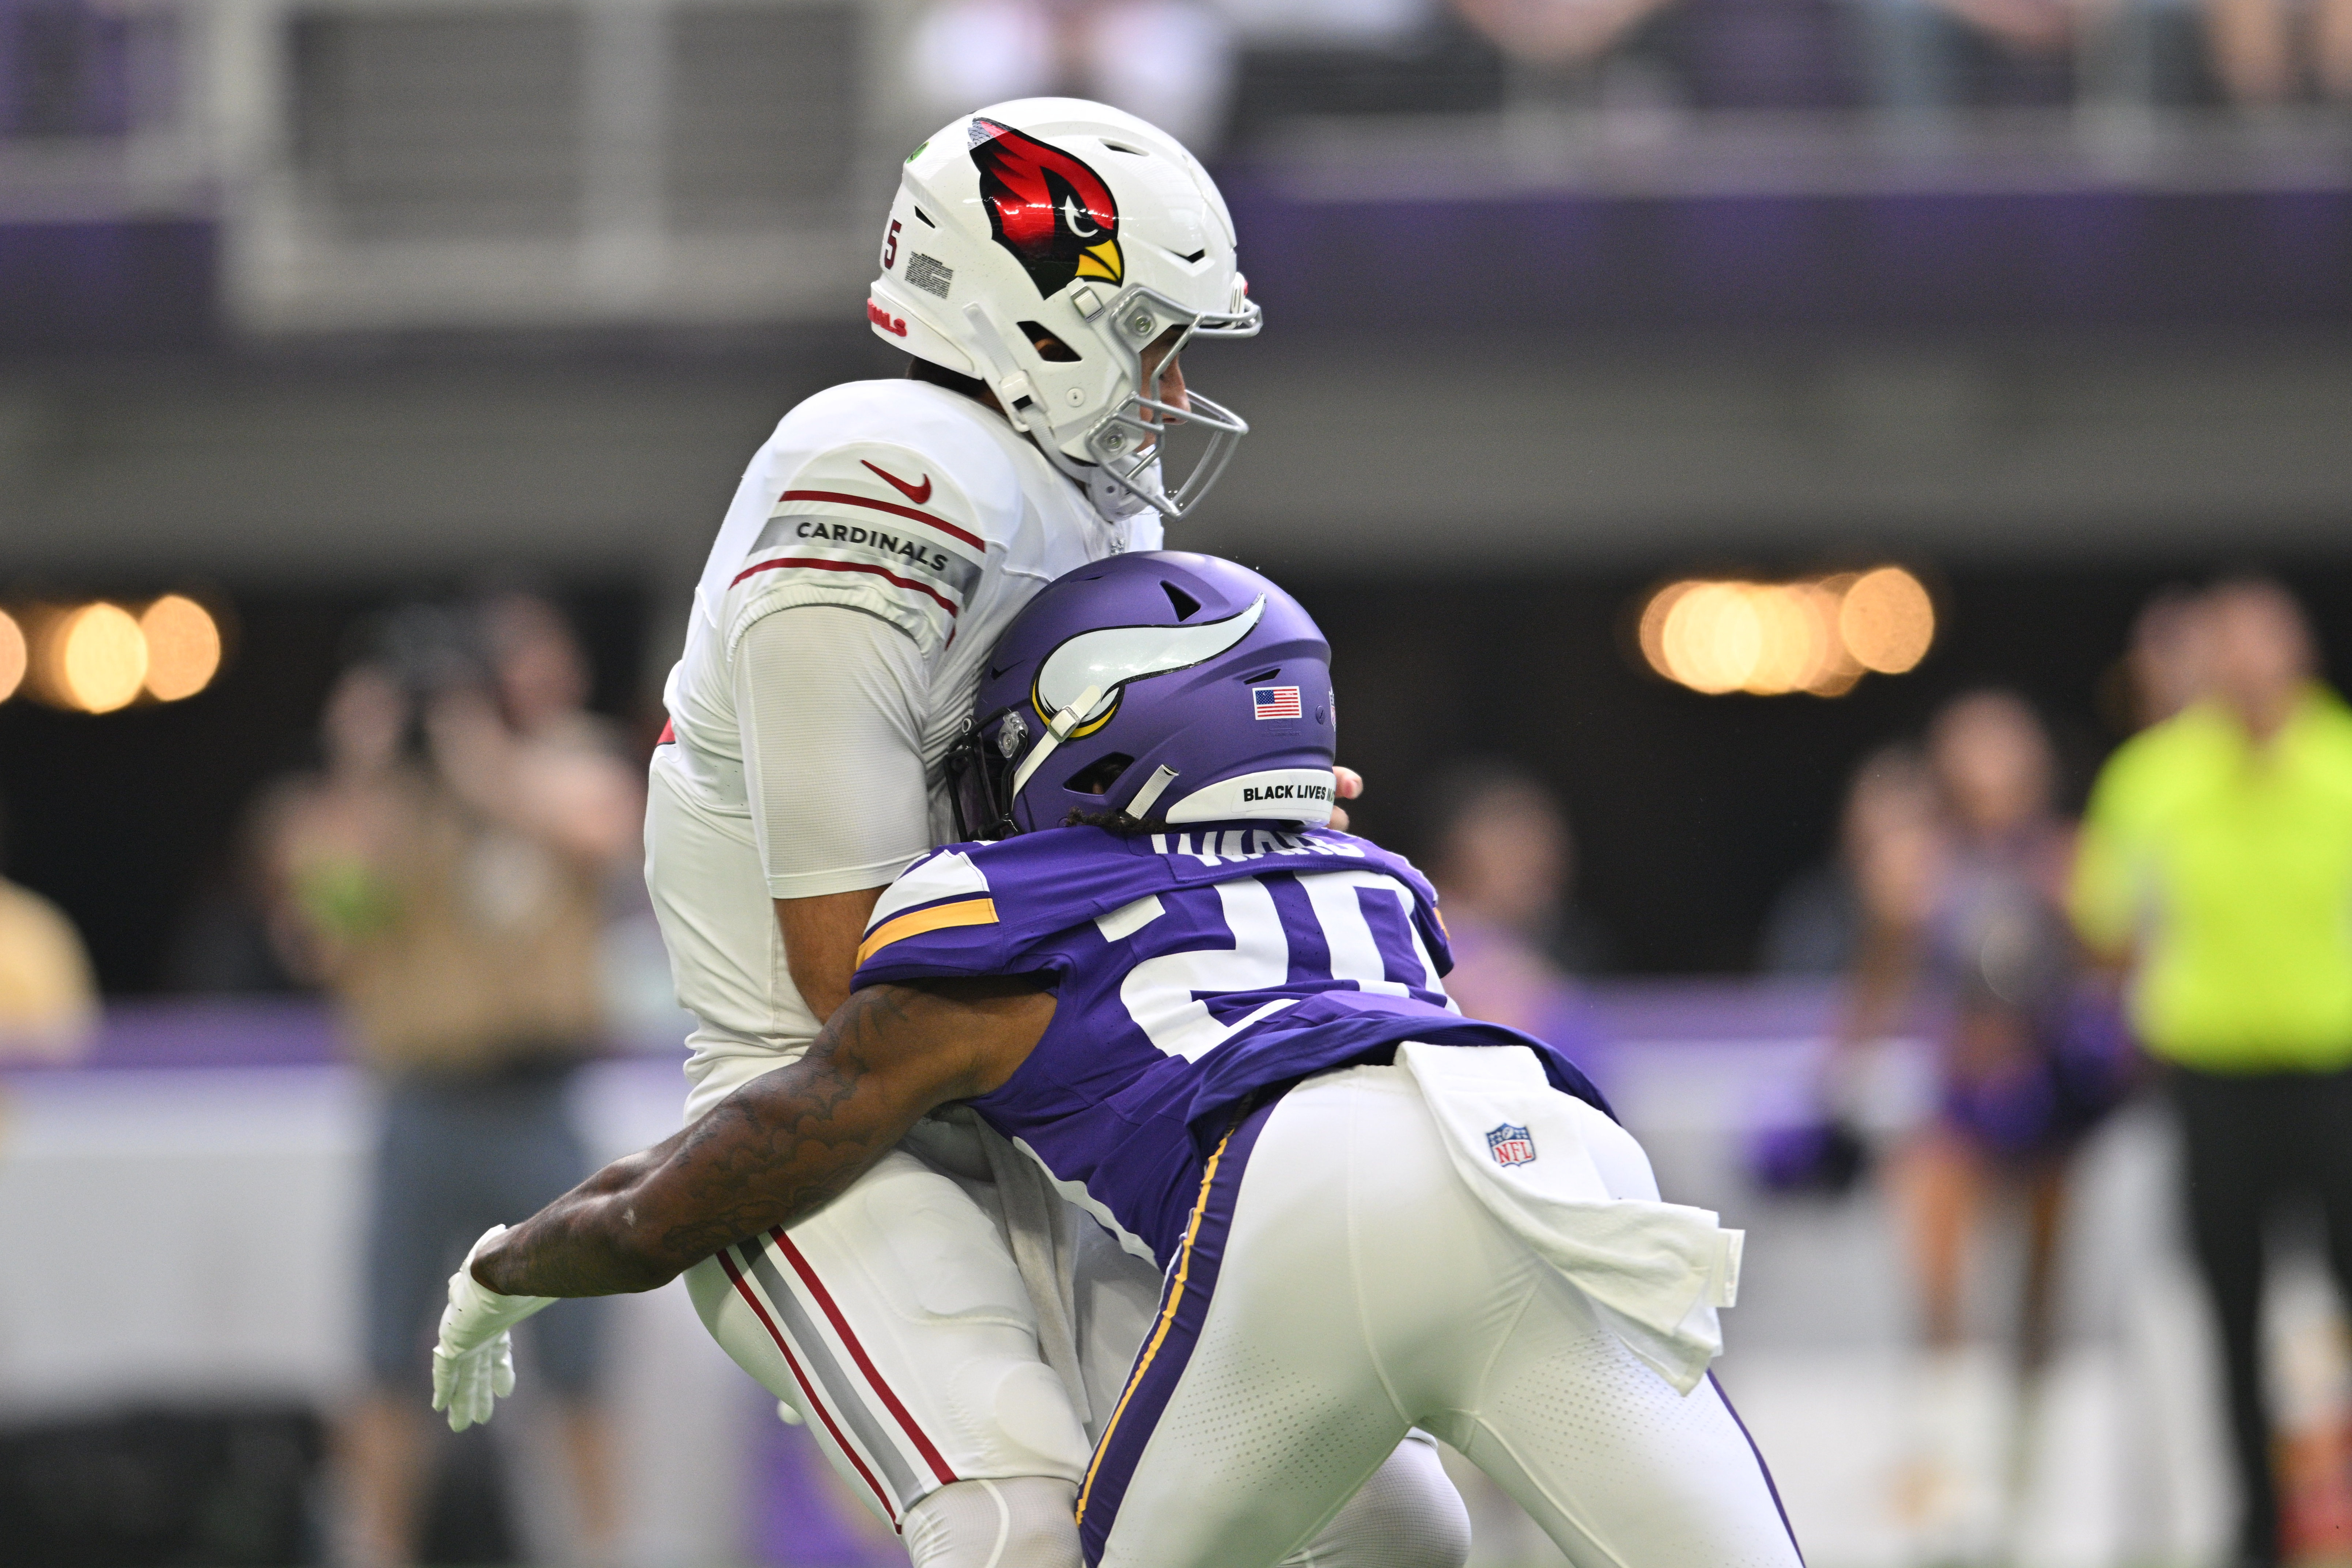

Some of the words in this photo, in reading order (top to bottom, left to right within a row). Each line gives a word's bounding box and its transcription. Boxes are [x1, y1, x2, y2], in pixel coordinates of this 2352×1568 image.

[884, 219, 902, 270] 5
[797, 522, 949, 571] CARDINALS
[1243, 785, 1294, 802] BLACK
[1297, 785, 1327, 800] LIVES
[1094, 870, 1462, 1064] 20
[1495, 1141, 1533, 1163] NFL
